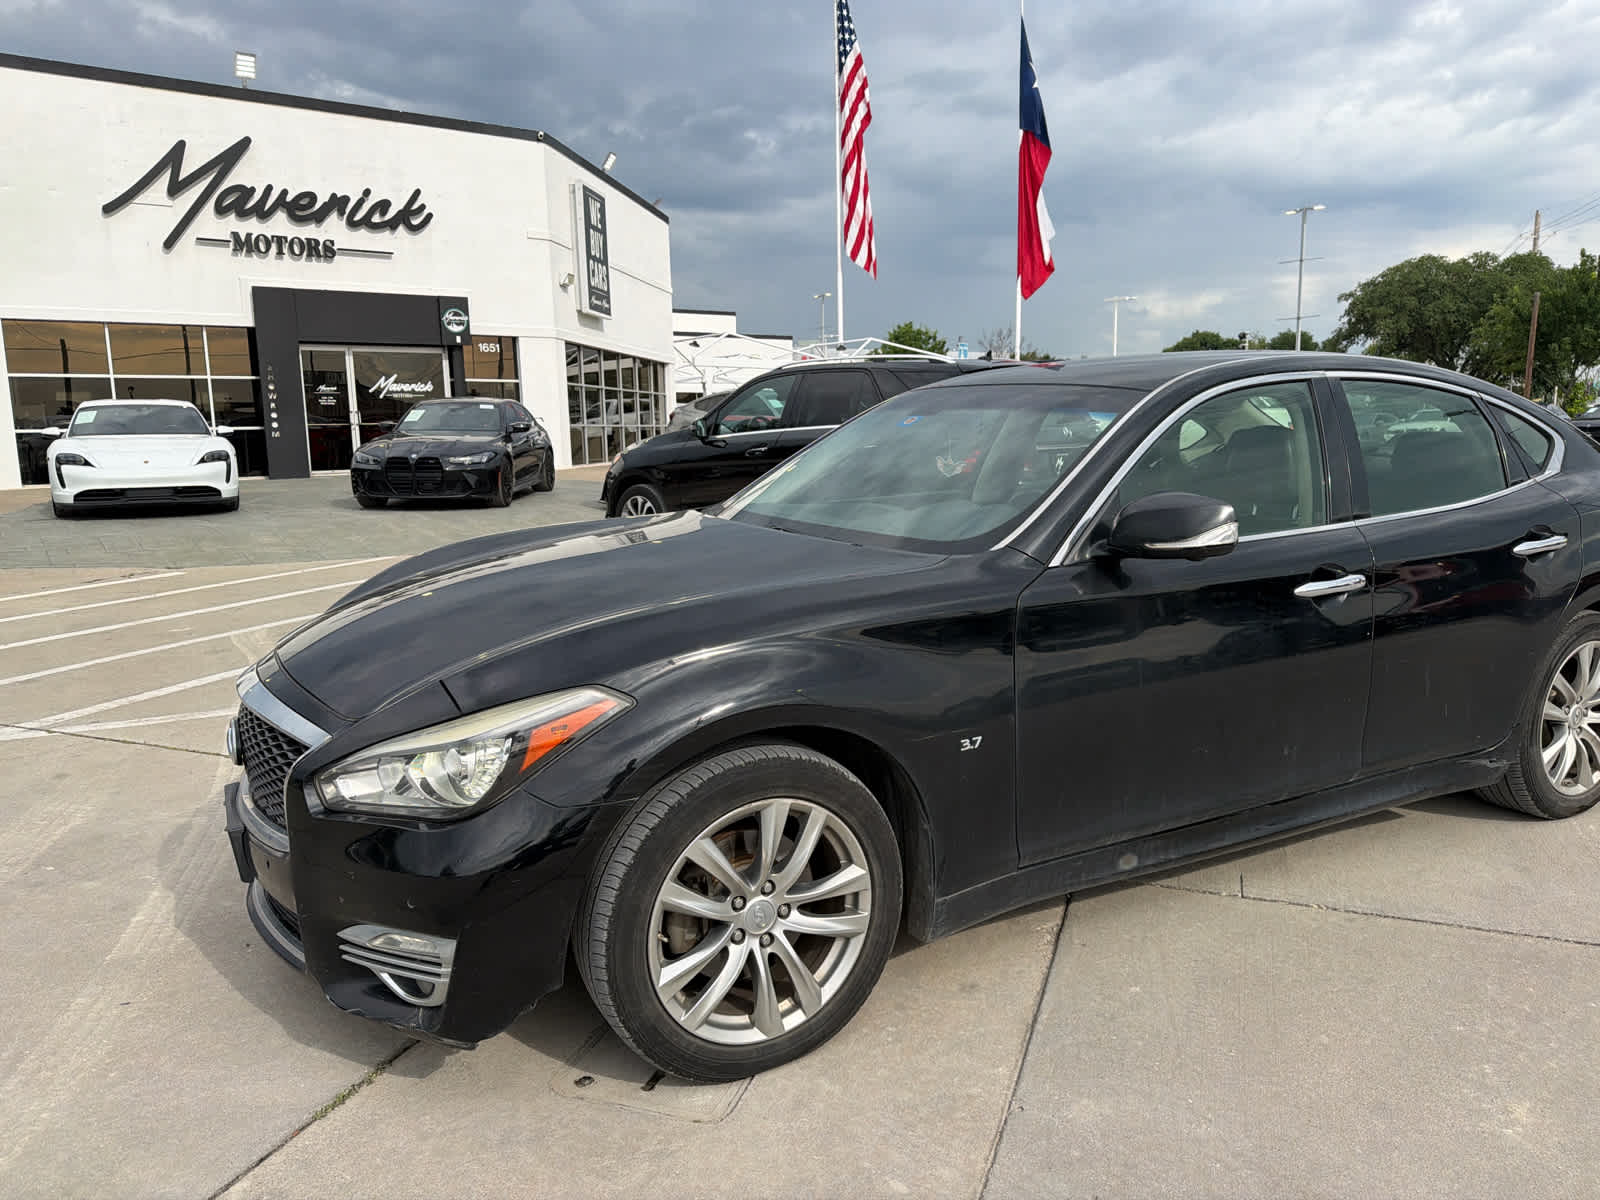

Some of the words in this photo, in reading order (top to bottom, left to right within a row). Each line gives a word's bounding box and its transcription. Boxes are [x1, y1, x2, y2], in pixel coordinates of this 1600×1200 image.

[102, 136, 433, 251] Maverick
[588, 196, 602, 229] WE
[231, 232, 337, 259] MOTORS
[590, 228, 604, 260] BUY
[589, 259, 608, 290] CARS
[478, 342, 500, 353] 1651
[368, 373, 434, 399] Maverick
[960, 735, 983, 752] 3.7
